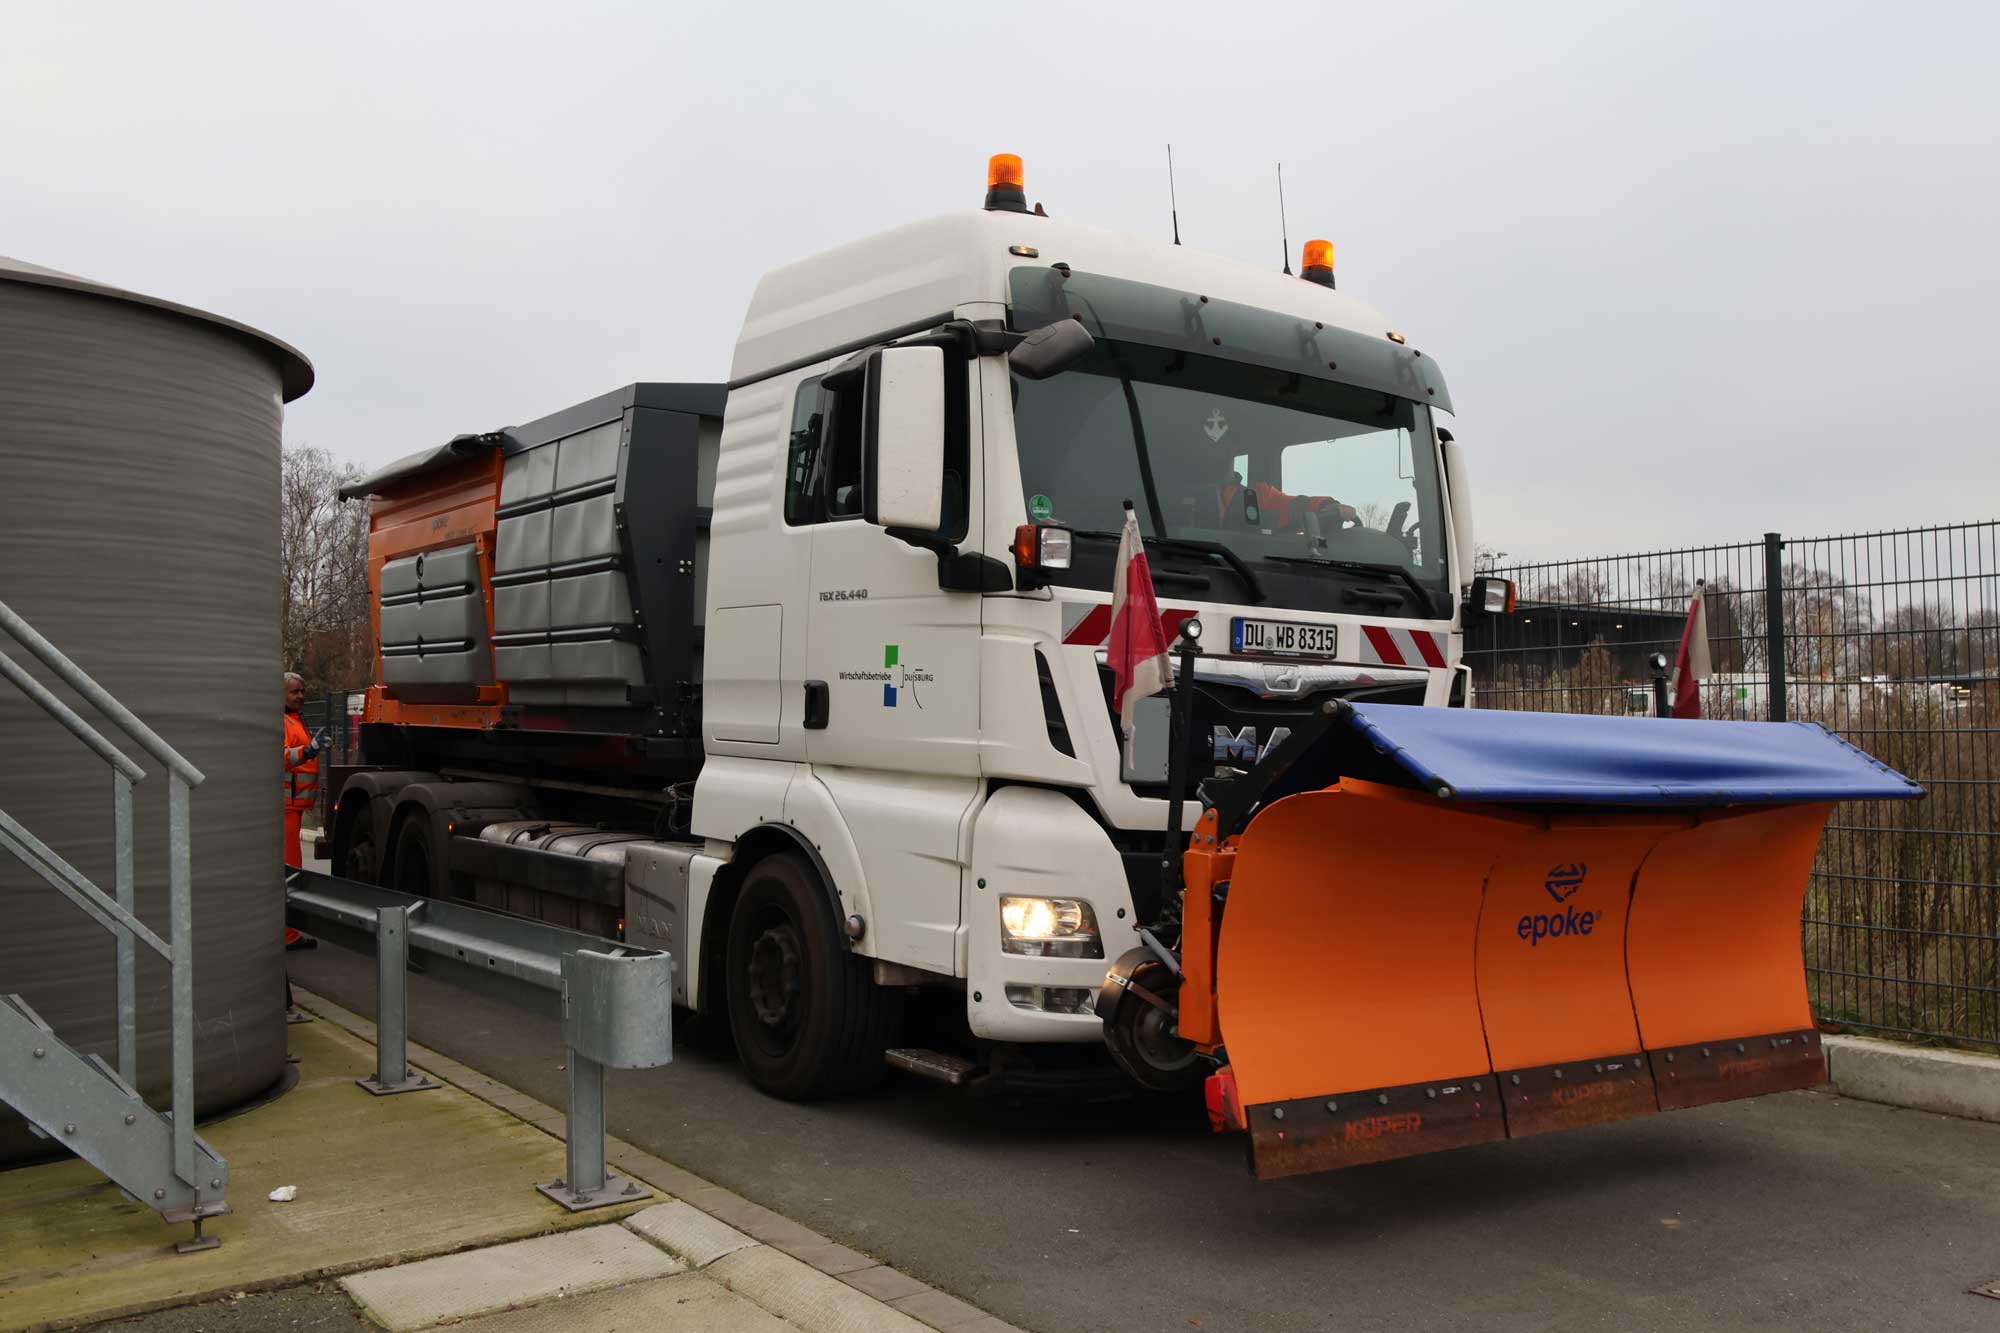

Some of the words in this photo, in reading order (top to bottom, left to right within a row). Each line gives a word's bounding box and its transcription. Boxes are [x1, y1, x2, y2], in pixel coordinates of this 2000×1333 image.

[1037, 496, 1044, 507] 4
[835, 589, 868, 601] 26.440
[1244, 623, 1265, 647] DU
[1276, 626, 1295, 649] WB
[1298, 627, 1334, 651] 8315
[839, 671, 892, 681] Wirtschaftsbetriebe
[904, 672, 934, 682] DUISBURG
[1517, 905, 1595, 946] epoke
